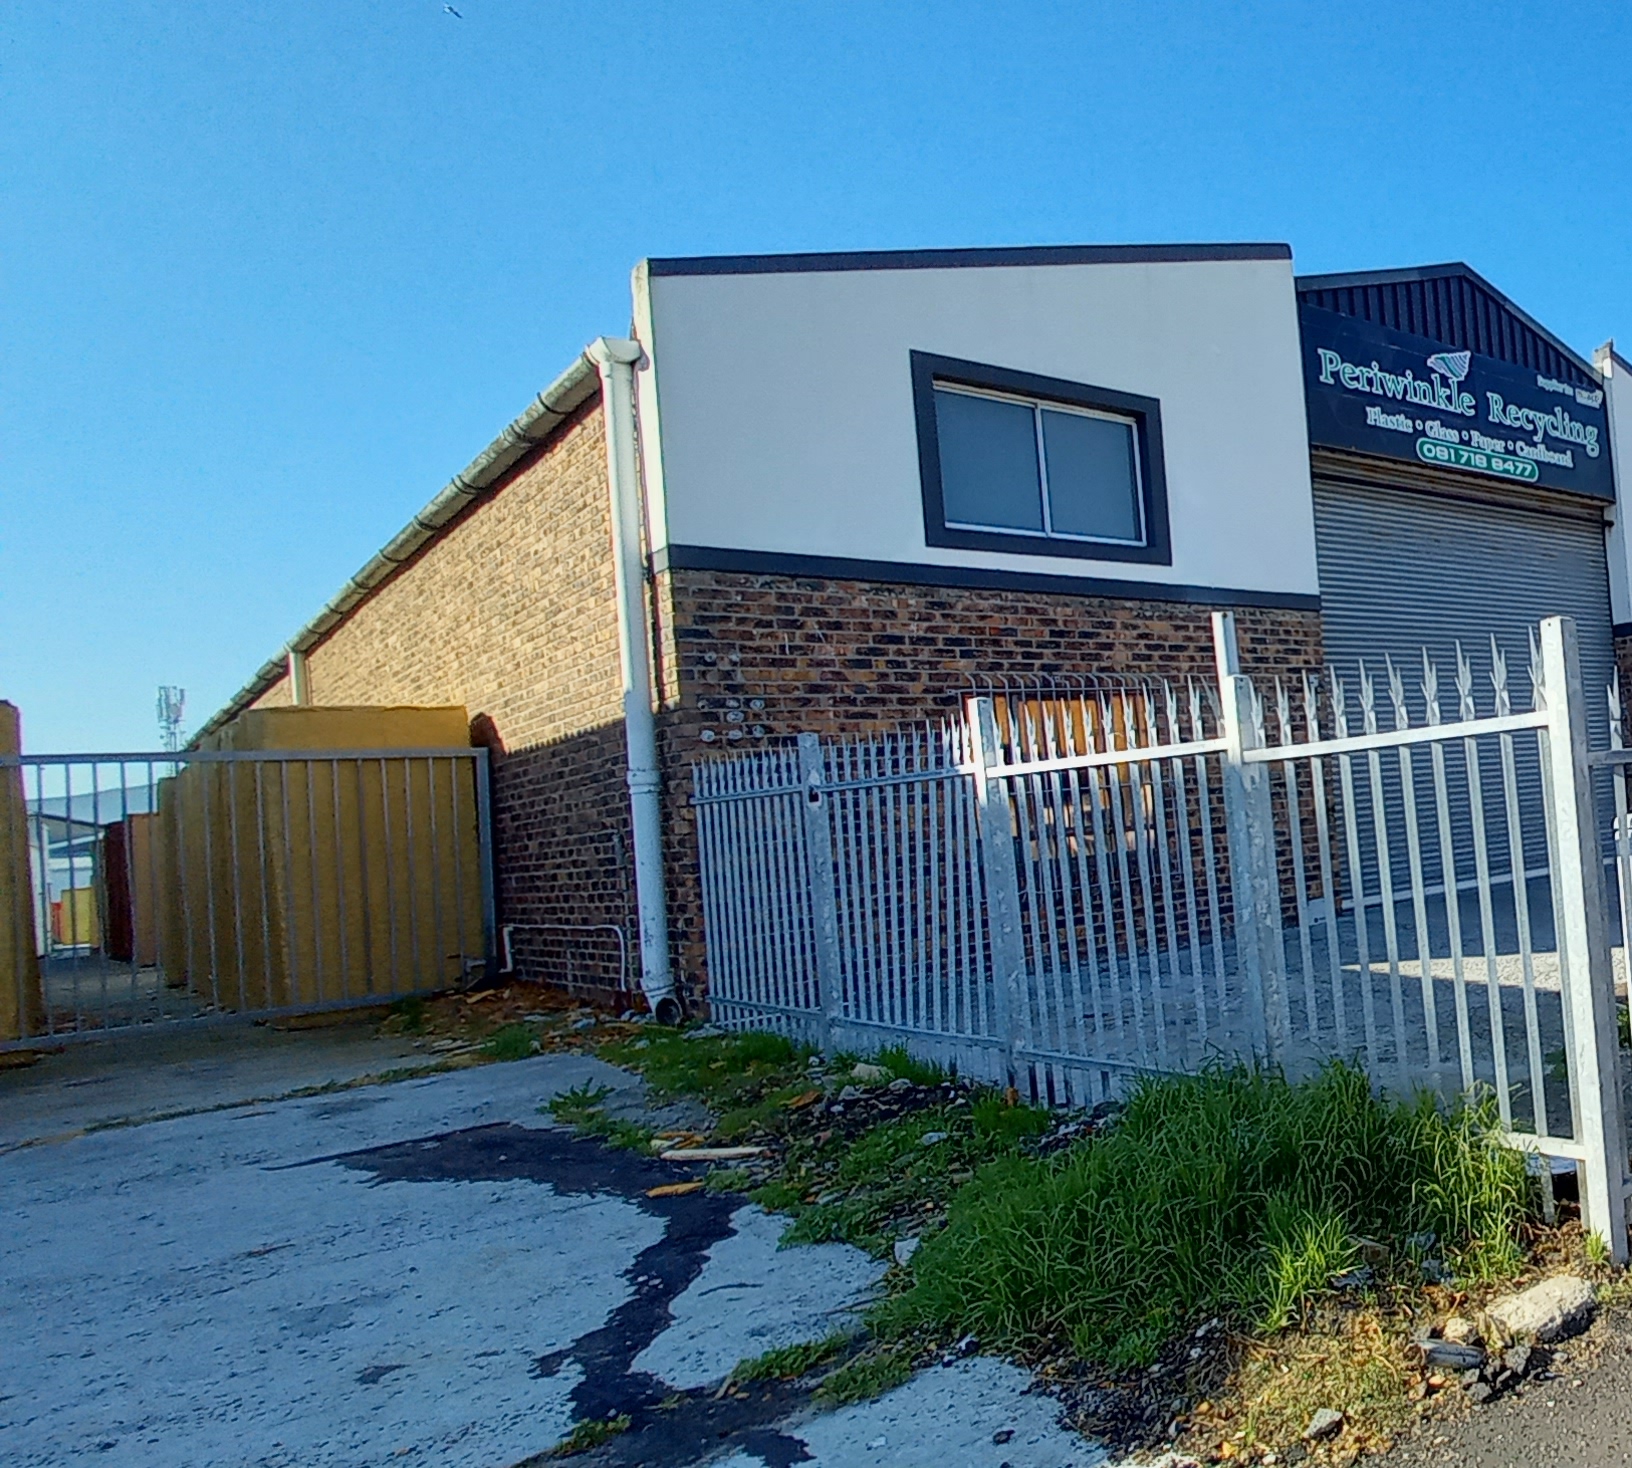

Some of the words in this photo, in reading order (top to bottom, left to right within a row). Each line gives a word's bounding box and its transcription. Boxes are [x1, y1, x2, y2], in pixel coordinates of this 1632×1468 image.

[1317, 348, 1476, 416] Periwinkle
[1486, 391, 1600, 458] Recycling
[1366, 406, 1414, 433] Plastic
[1425, 420, 1459, 443] Glass
[1470, 430, 1505, 453] Paper
[1515, 441, 1574, 468] Cardboard
[1423, 443, 1455, 463] 081
[1459, 450, 1487, 468] 718
[1491, 457, 1532, 477] 8477
